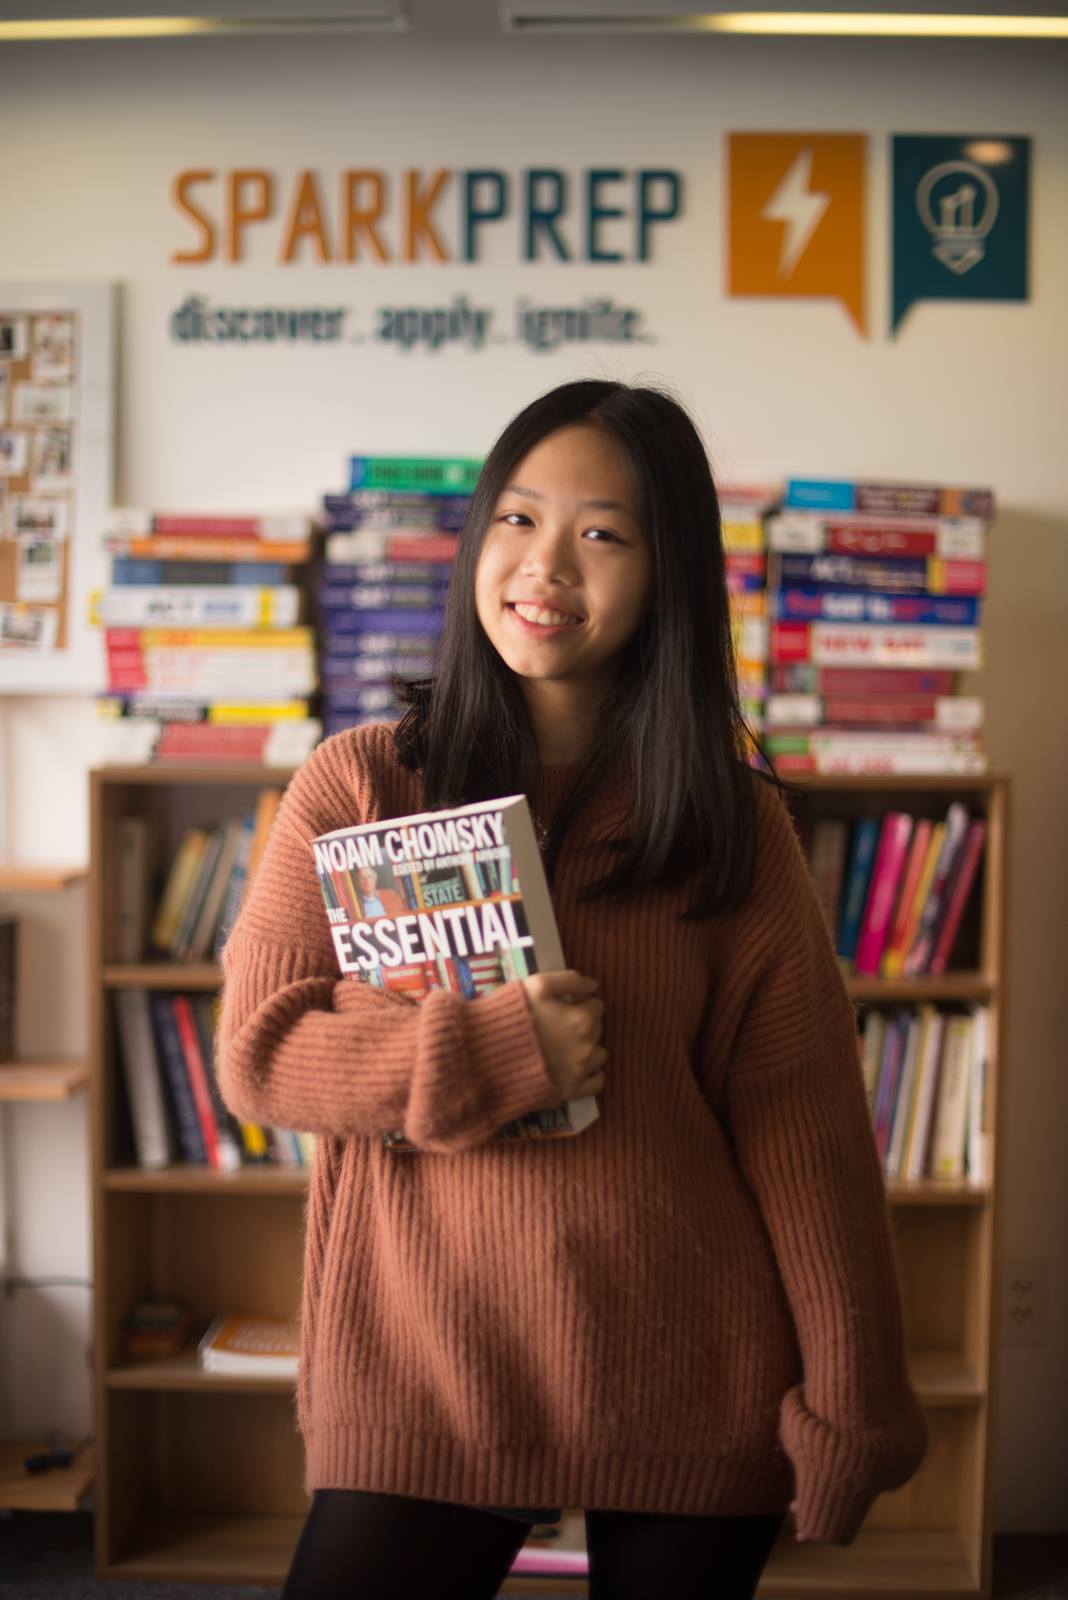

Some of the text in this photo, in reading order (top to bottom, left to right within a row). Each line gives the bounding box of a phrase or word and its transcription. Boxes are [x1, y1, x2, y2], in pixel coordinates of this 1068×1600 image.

[170, 168, 684, 264] SPARKPREP
[313, 811, 505, 875] NOAM CHOMSKY
[326, 907, 348, 924] THE
[423, 882, 465, 907] STATE
[330, 899, 534, 973] ESSENTIAL
